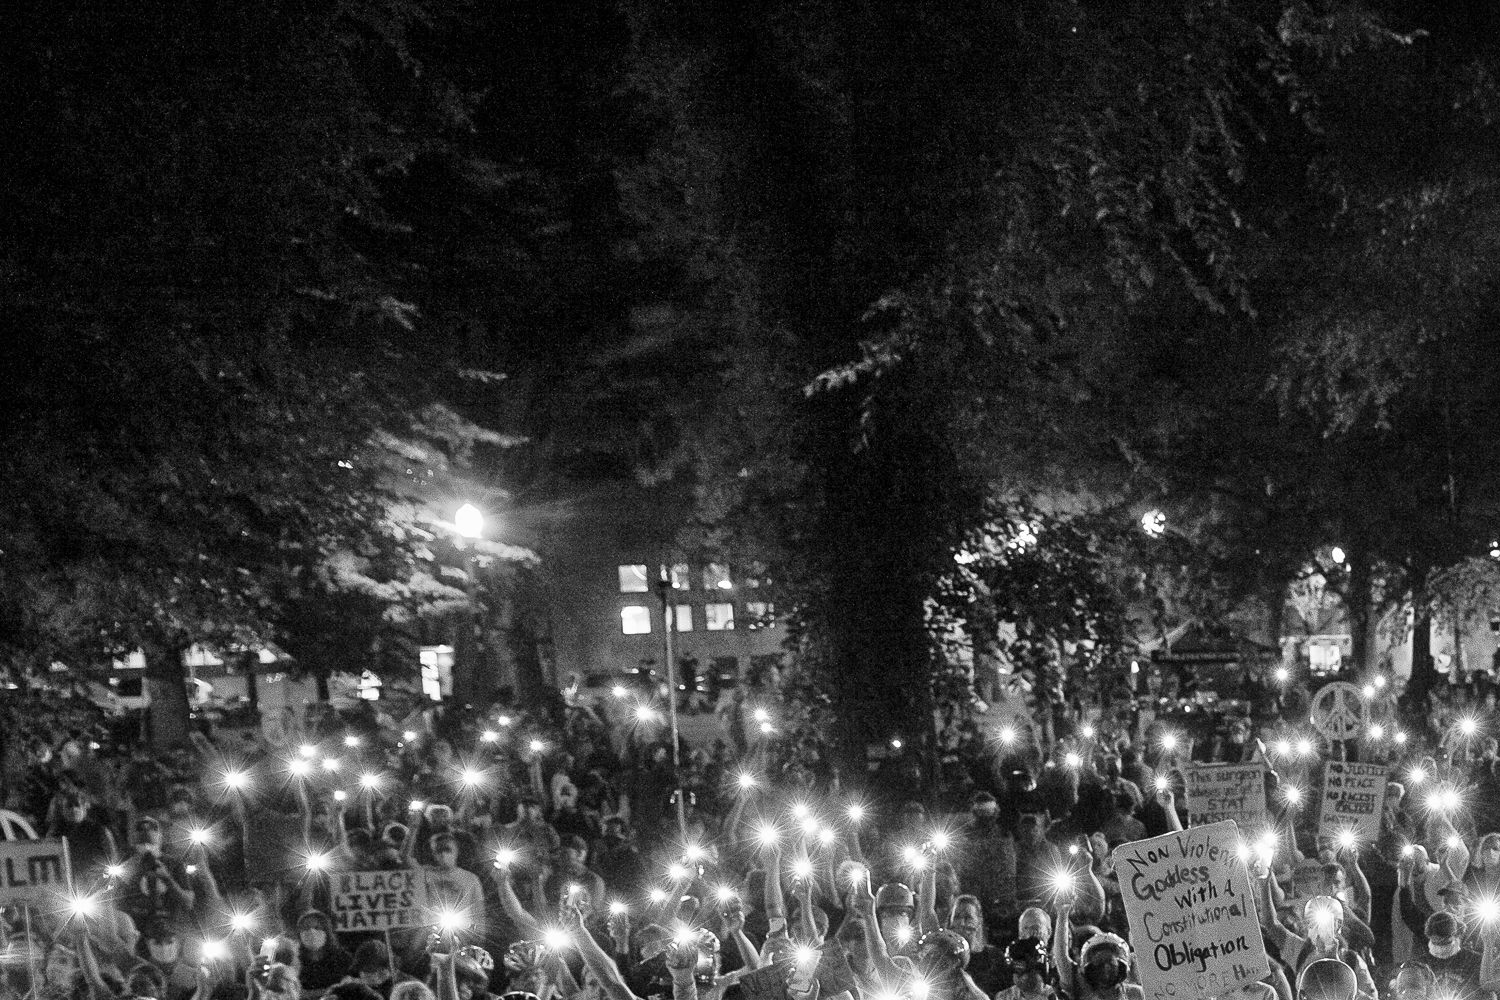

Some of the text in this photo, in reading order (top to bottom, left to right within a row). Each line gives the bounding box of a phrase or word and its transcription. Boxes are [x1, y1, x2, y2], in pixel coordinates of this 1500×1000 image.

[1177, 836, 1232, 868] Violen
[335, 890, 414, 911] LIVES
[1154, 935, 1250, 973] Obligation
